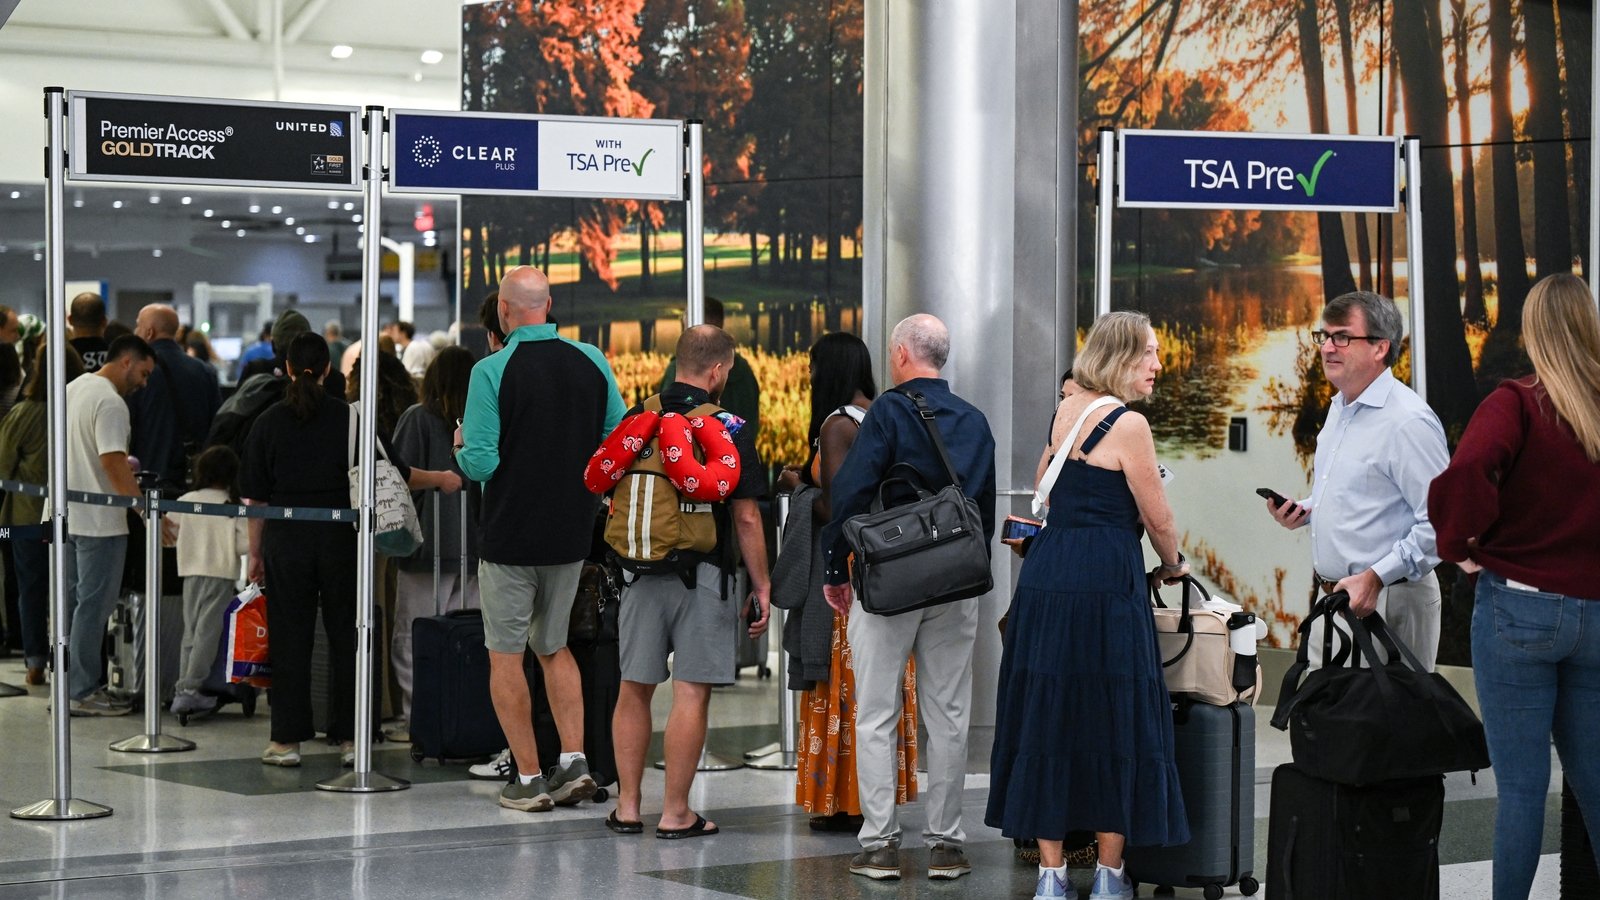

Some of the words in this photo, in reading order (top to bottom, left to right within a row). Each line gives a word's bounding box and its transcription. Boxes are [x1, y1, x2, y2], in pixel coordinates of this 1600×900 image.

[101, 120, 164, 139] Premier
[275, 121, 327, 132] UNITED
[101, 140, 216, 160] GOLDTRACK
[595, 139, 622, 149] WITH
[495, 162, 515, 171] PLUS
[566, 152, 599, 172] TSA
[603, 154, 631, 173] Pre
[1183, 158, 1240, 190] TSA
[1247, 160, 1294, 191] Pre
